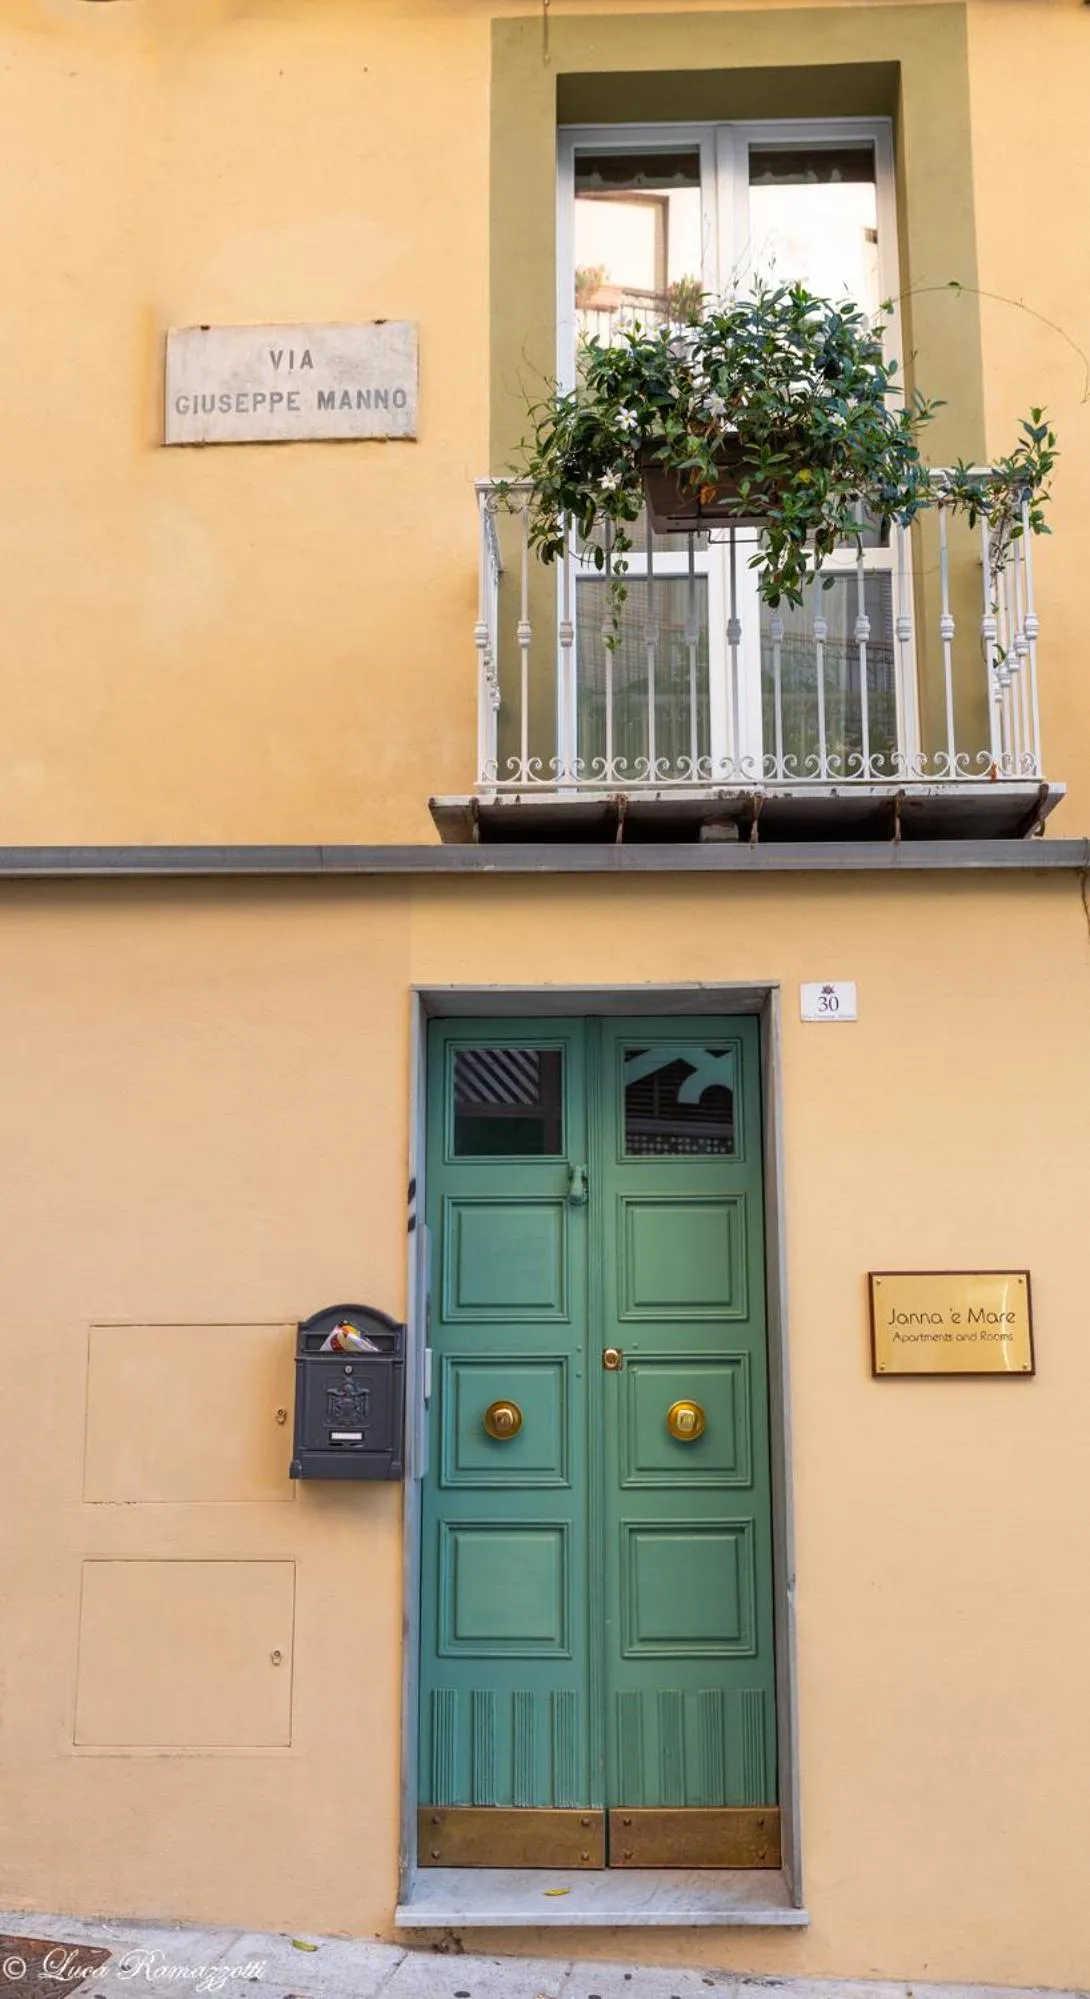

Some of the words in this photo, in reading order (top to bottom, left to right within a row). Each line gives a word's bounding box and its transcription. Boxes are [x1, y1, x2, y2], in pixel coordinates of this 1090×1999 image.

[270, 349, 314, 370] VIA
[175, 391, 301, 415] GIUSEPPE
[317, 389, 407, 412] MANNO
[818, 996, 839, 1012] 30
[888, 1308, 944, 1326] Janna
[967, 1307, 1016, 1325] Mare
[892, 1331, 953, 1343] Apartments
[955, 1331, 977, 1342] and
[980, 1330, 1014, 1342] Rooms
